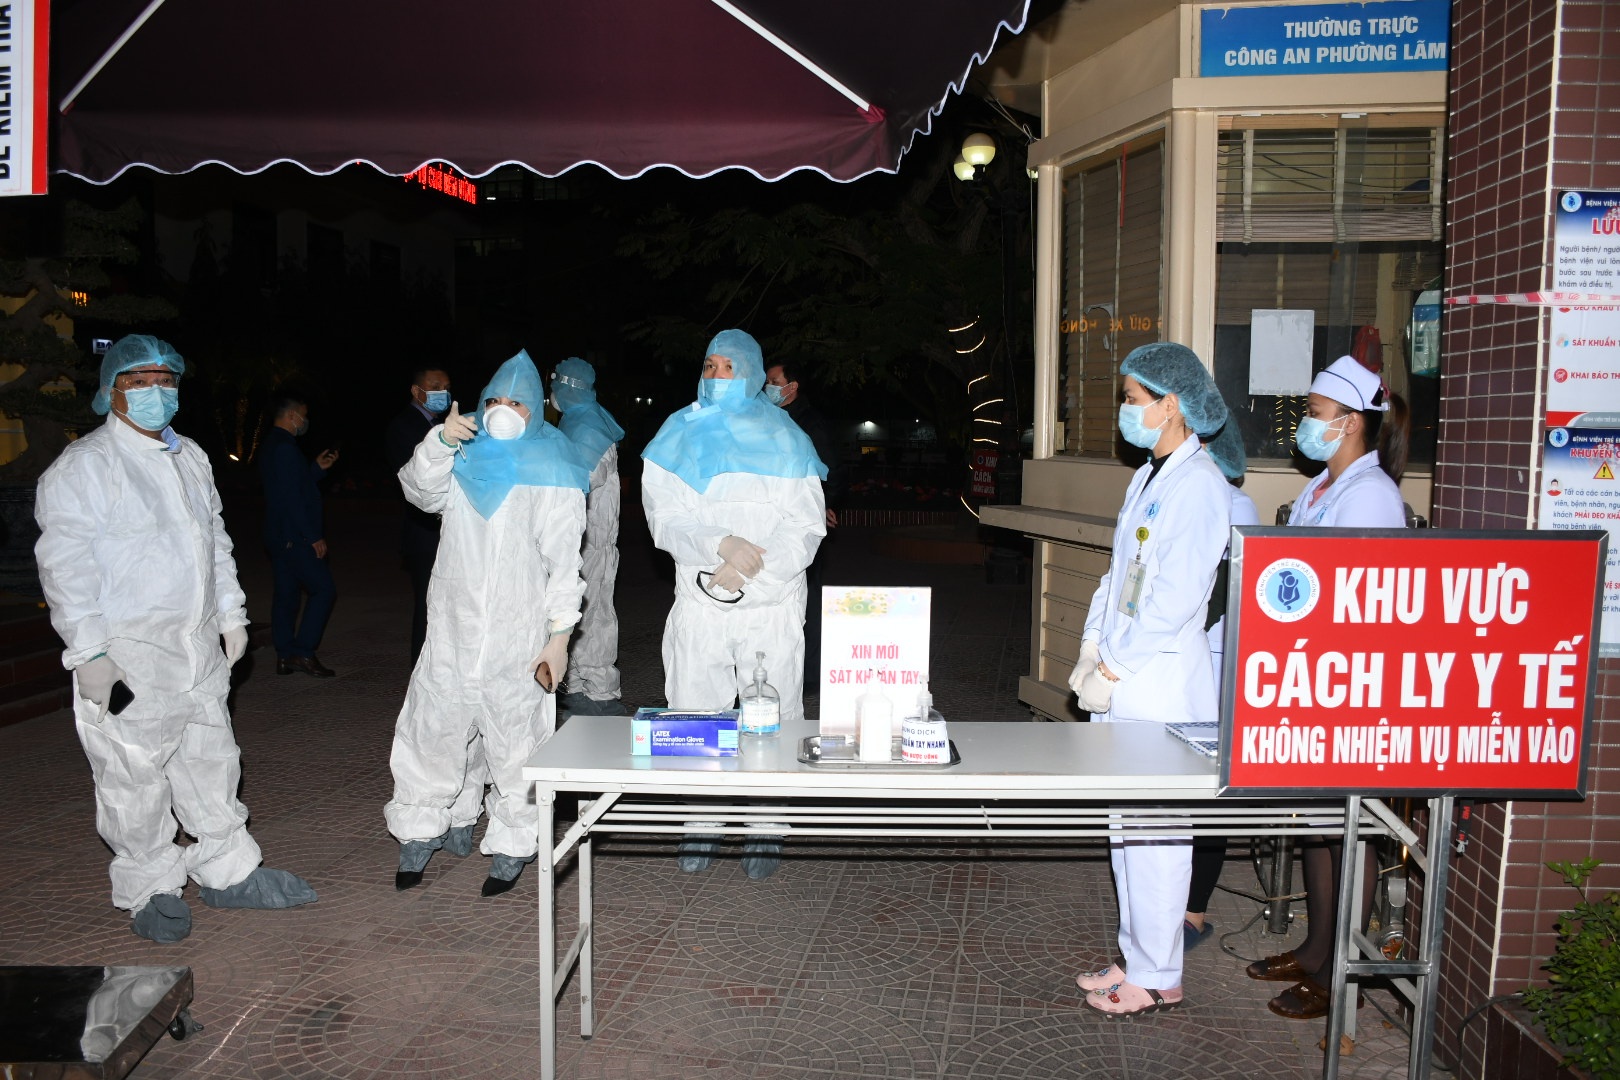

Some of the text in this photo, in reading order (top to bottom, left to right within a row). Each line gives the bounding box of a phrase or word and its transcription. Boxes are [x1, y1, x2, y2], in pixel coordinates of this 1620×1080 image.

[1284, 16, 1419, 38] THƯỜNG TRỰC
[1225, 40, 1447, 66] CÔNG AN PHƯỜNG LÃM
[1570, 371, 1589, 379] KHAI
[1332, 562, 1530, 637] KHU VỰC
[851, 644, 872, 659] XIN
[901, 670, 919, 684] TAY
[1243, 635, 1583, 708] CÁCH LY Y TẾ
[1241, 711, 1575, 771] KHÔNG NHIỆM VỤ MIỄN VÀO
